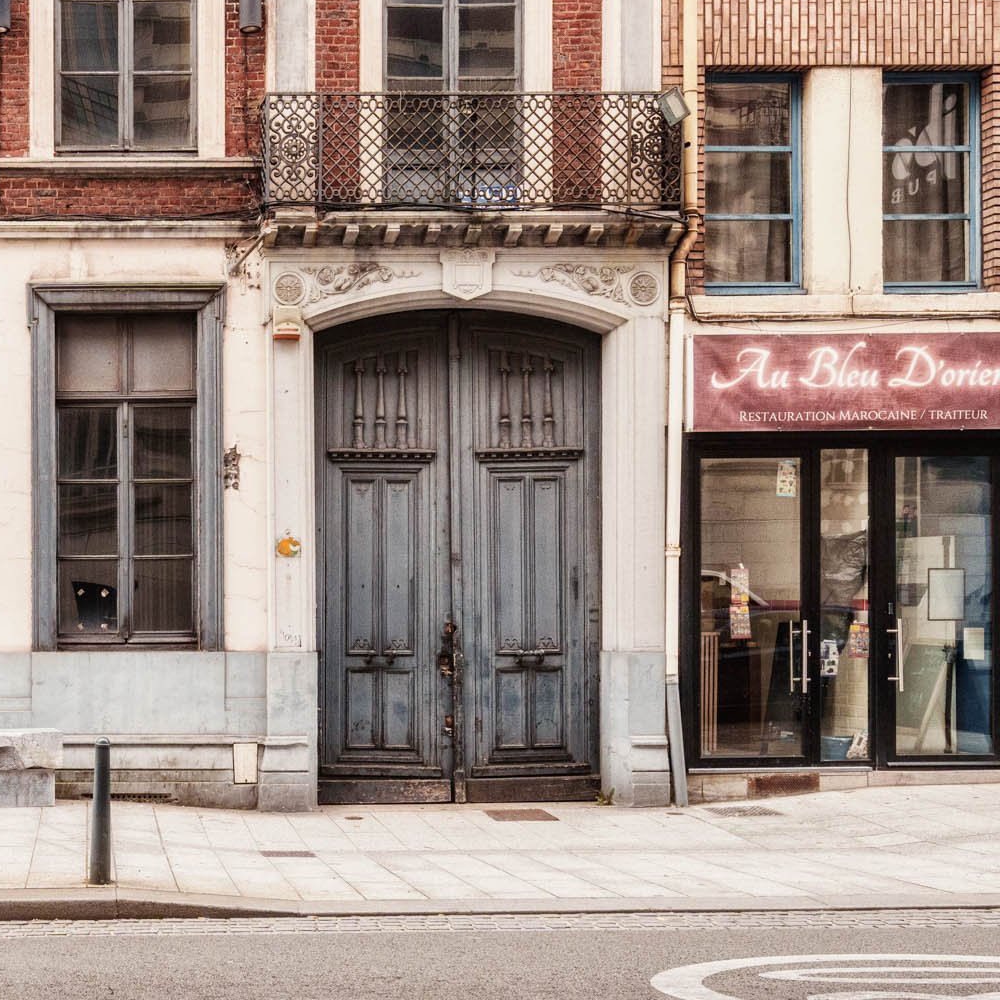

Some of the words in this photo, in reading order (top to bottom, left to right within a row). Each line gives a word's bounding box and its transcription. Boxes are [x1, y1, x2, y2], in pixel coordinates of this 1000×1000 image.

[711, 347, 789, 389] Au
[799, 341, 879, 388] Bleu
[739, 410, 835, 422] RESTAURATION
[839, 409, 917, 421] MAROCAINE
[928, 409, 988, 420] TRAITEUR
